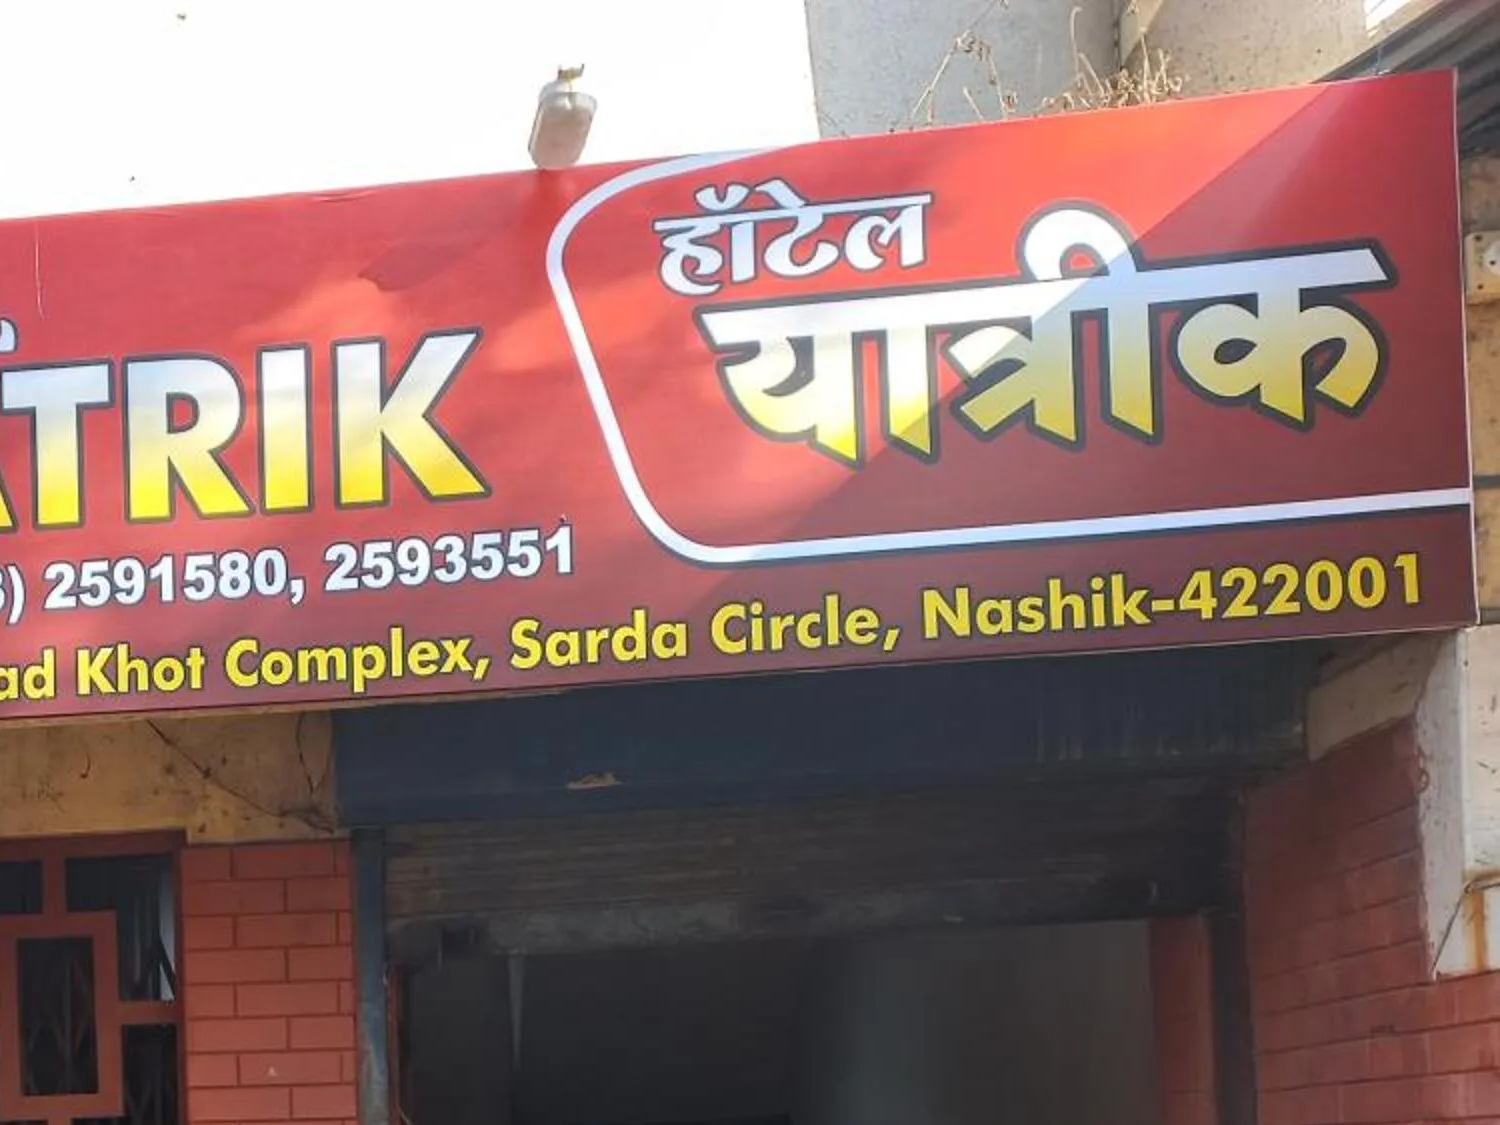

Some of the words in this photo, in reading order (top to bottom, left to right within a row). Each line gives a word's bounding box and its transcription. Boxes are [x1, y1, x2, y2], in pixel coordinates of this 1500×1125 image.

[654, 180, 932, 297] हॉटेल
[694, 200, 1398, 470] यात्रीक
[43, 549, 307, 606] 2591580,
[324, 524, 575, 592] 2593551
[75, 642, 207, 698] Khot
[224, 625, 490, 695] Complex,
[509, 608, 688, 669] Sarda
[710, 592, 903, 656] Circle,
[922, 551, 1424, 641] Nashik-422001
